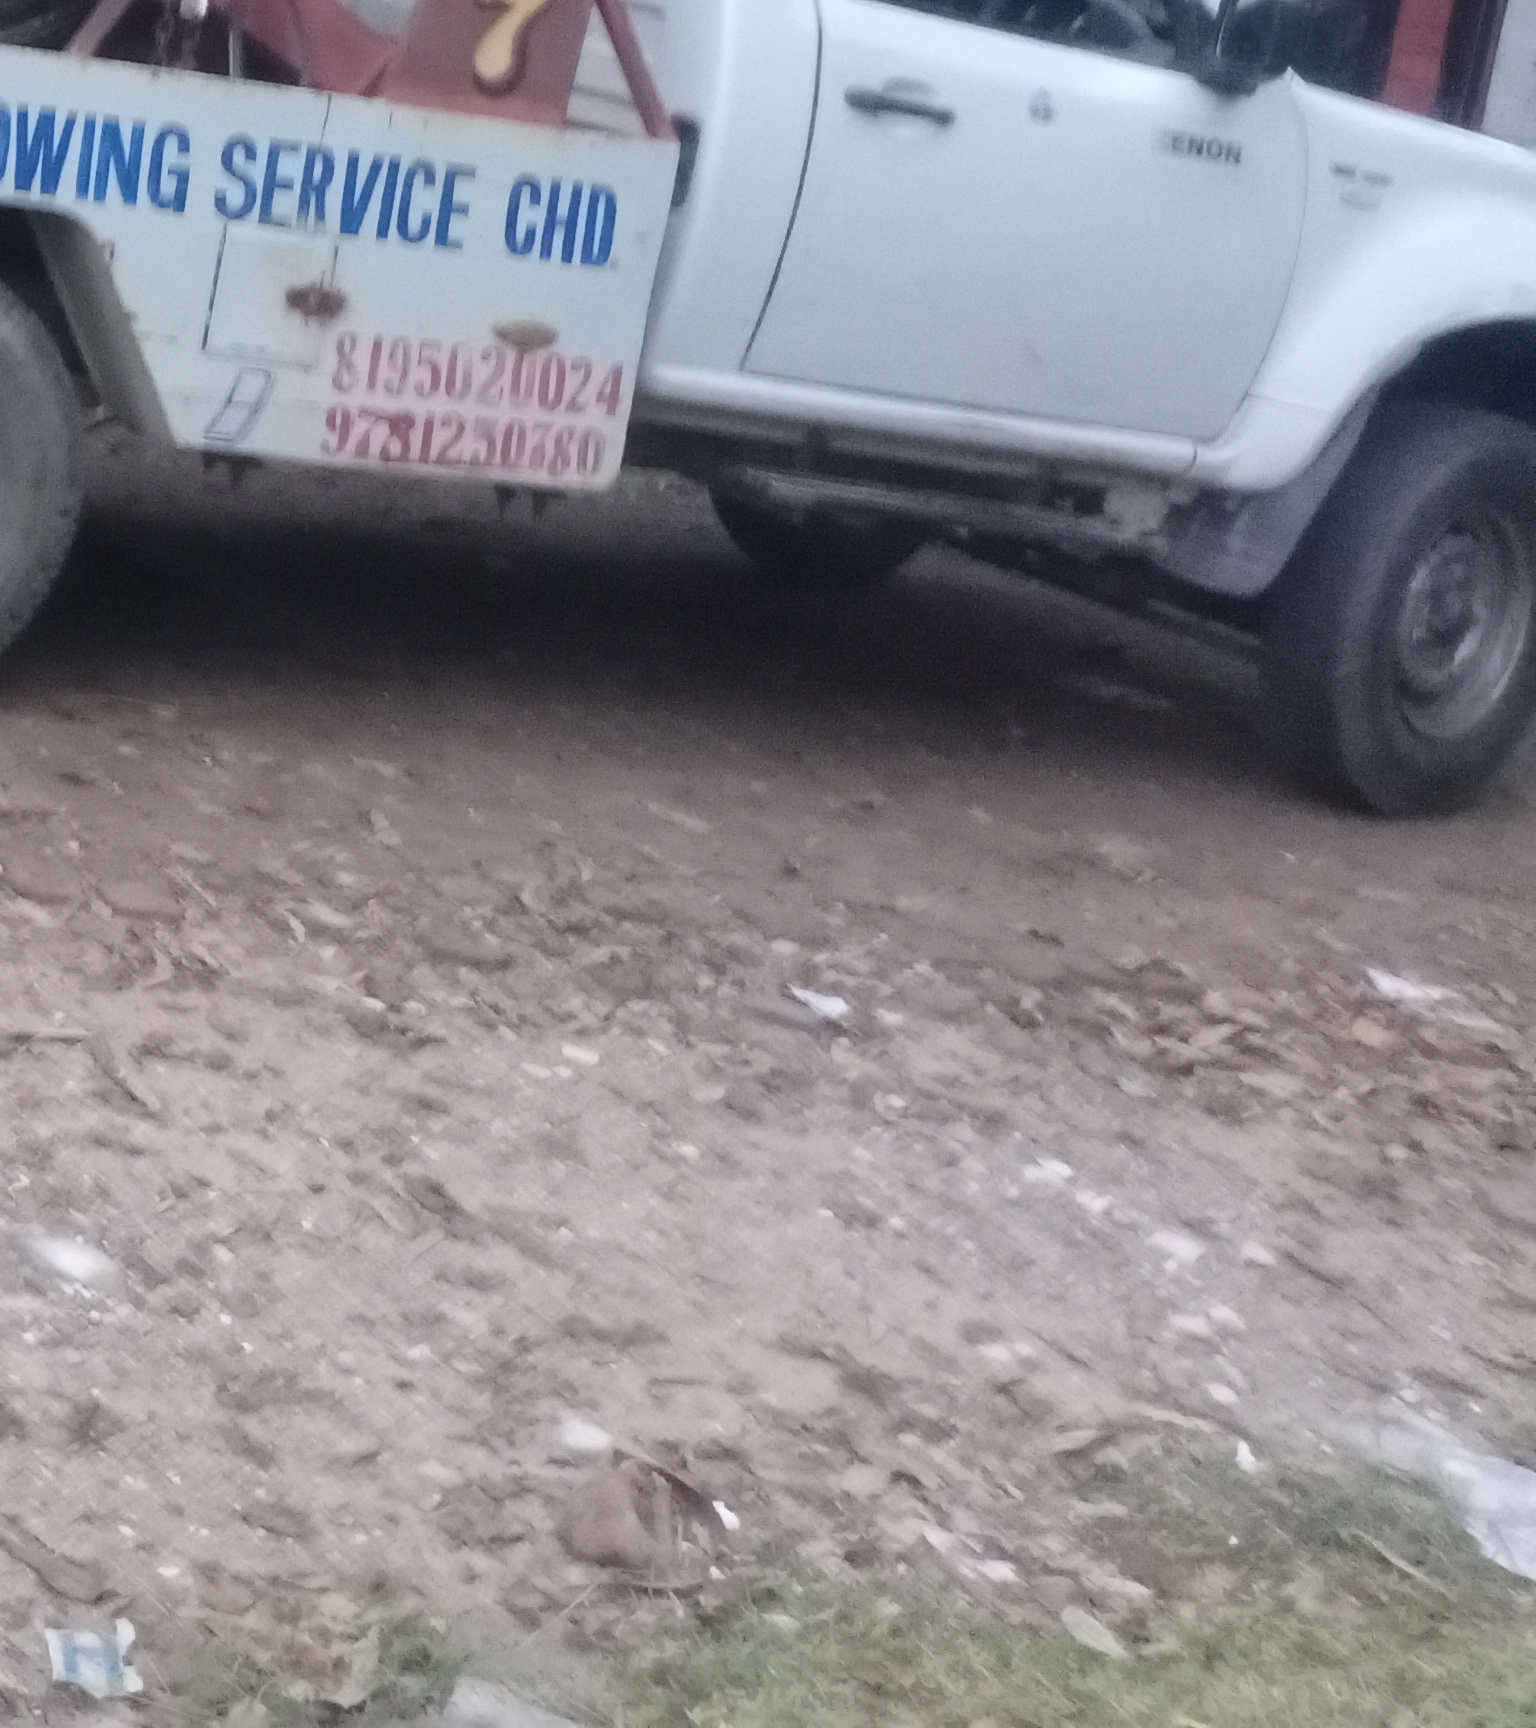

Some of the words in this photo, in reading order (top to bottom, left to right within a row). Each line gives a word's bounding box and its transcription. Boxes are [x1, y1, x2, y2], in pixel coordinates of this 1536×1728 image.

[214, 131, 477, 249] SERVICE
[504, 173, 618, 267] CHD
[331, 329, 624, 416] 8195020024
